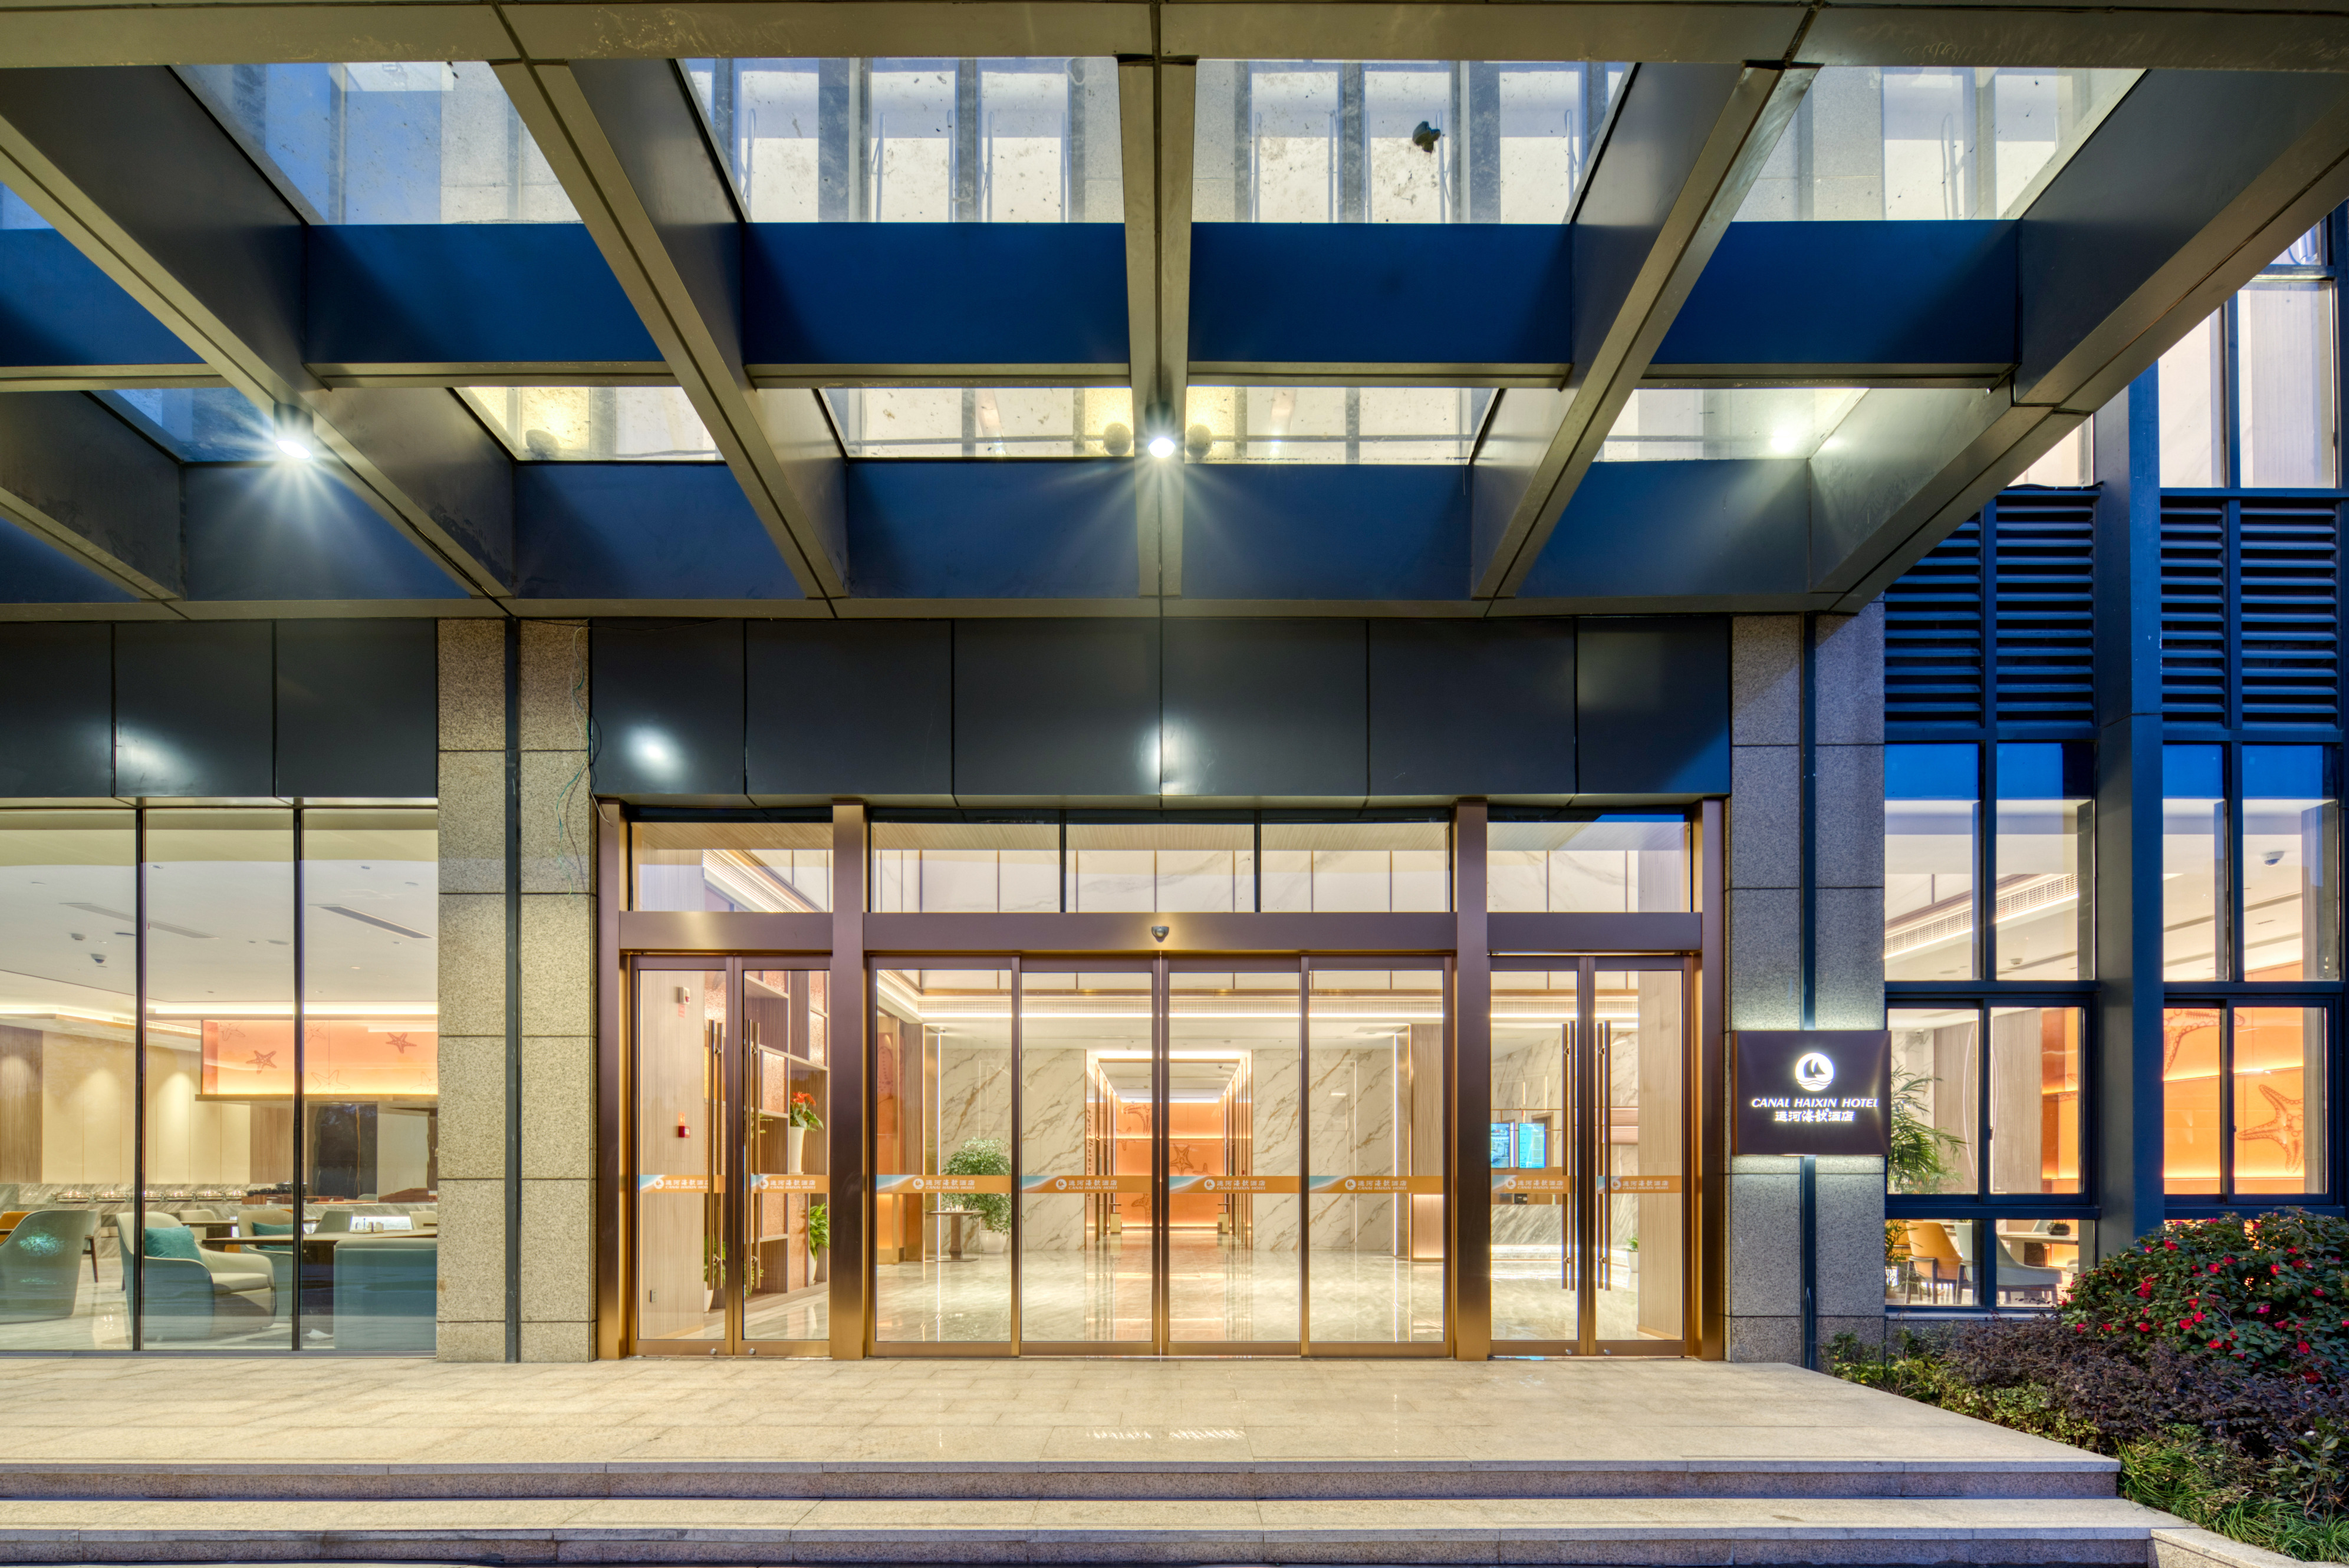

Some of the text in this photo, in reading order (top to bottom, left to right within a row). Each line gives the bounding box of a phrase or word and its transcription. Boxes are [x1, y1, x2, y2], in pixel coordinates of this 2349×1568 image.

[1751, 1098, 1879, 1108] CANAL HAIXIN HOTEL
